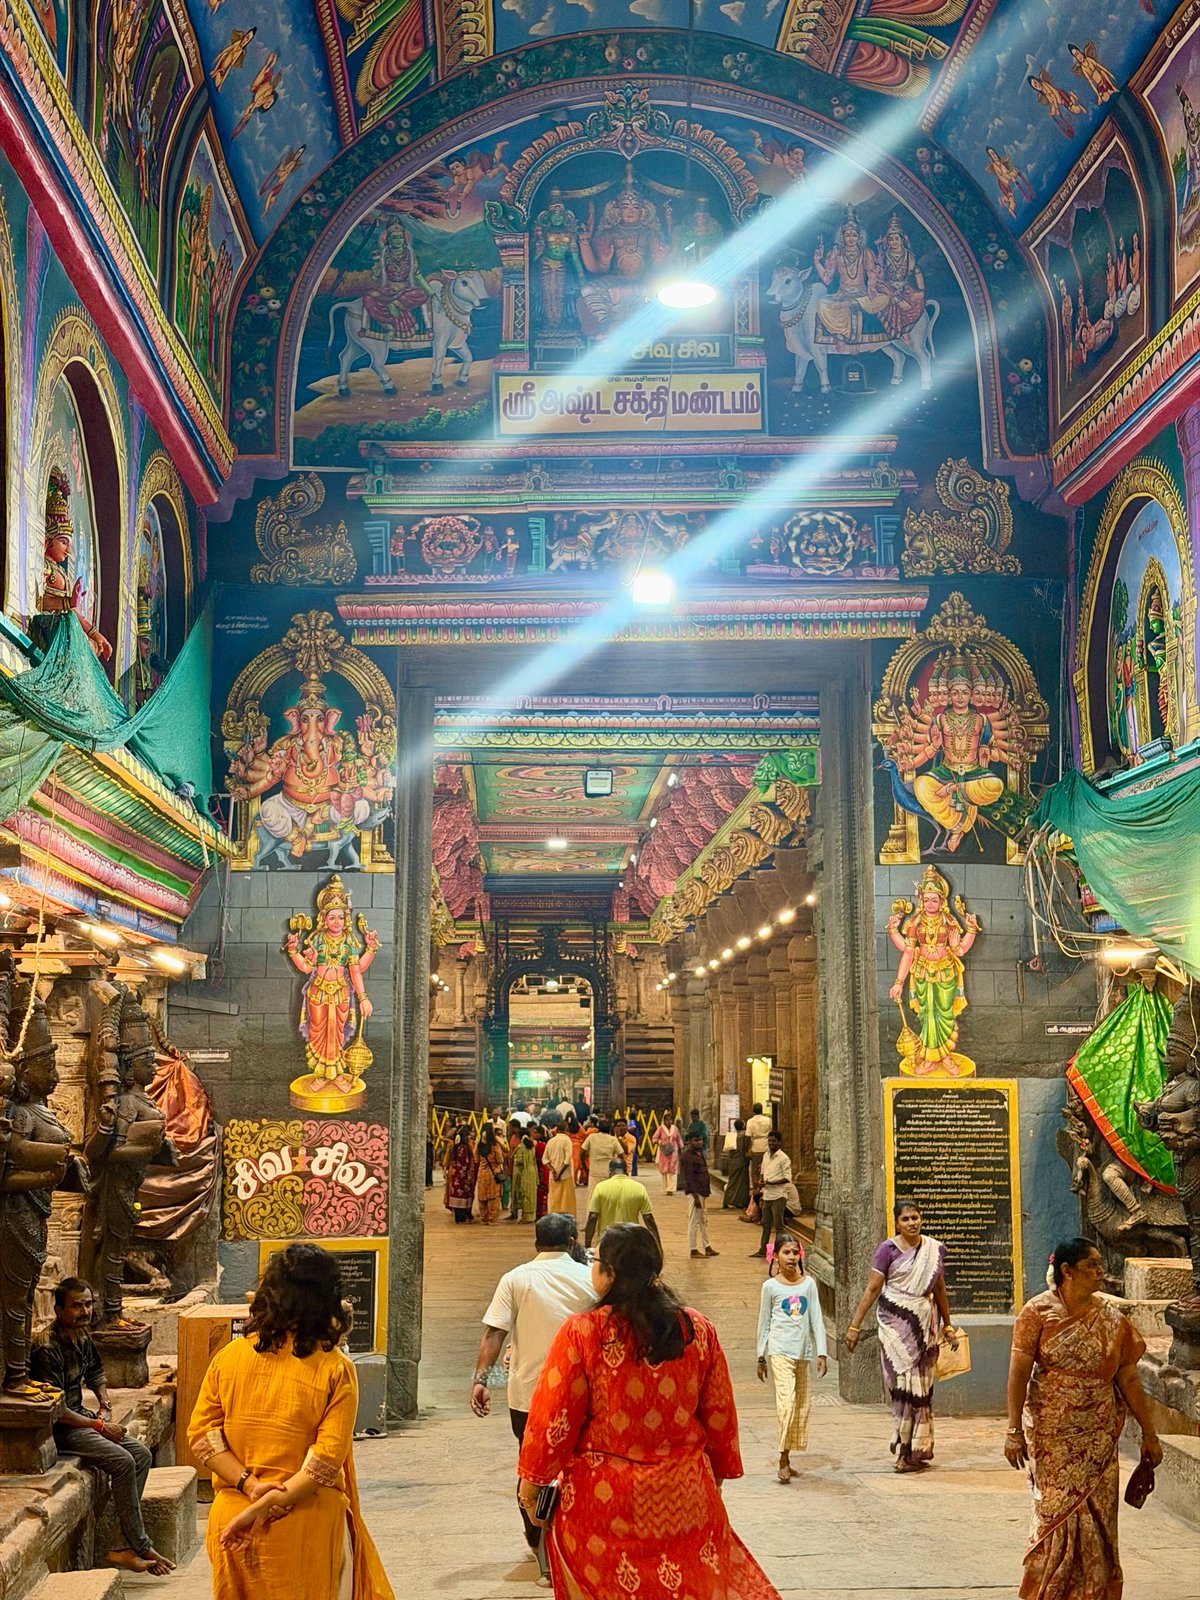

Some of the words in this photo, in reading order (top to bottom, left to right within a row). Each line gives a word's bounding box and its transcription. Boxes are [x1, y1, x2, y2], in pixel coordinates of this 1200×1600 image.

[678, 339, 719, 358] சிவ
[502, 381, 536, 420] ஸ்ரீ
[540, 385, 611, 423] அஷ்ட
[613, 382, 669, 422] சக்தி
[671, 382, 760, 414] மண்டபம்
[232, 1145, 293, 1200] சிவ
[310, 1142, 379, 1196] சிவ
